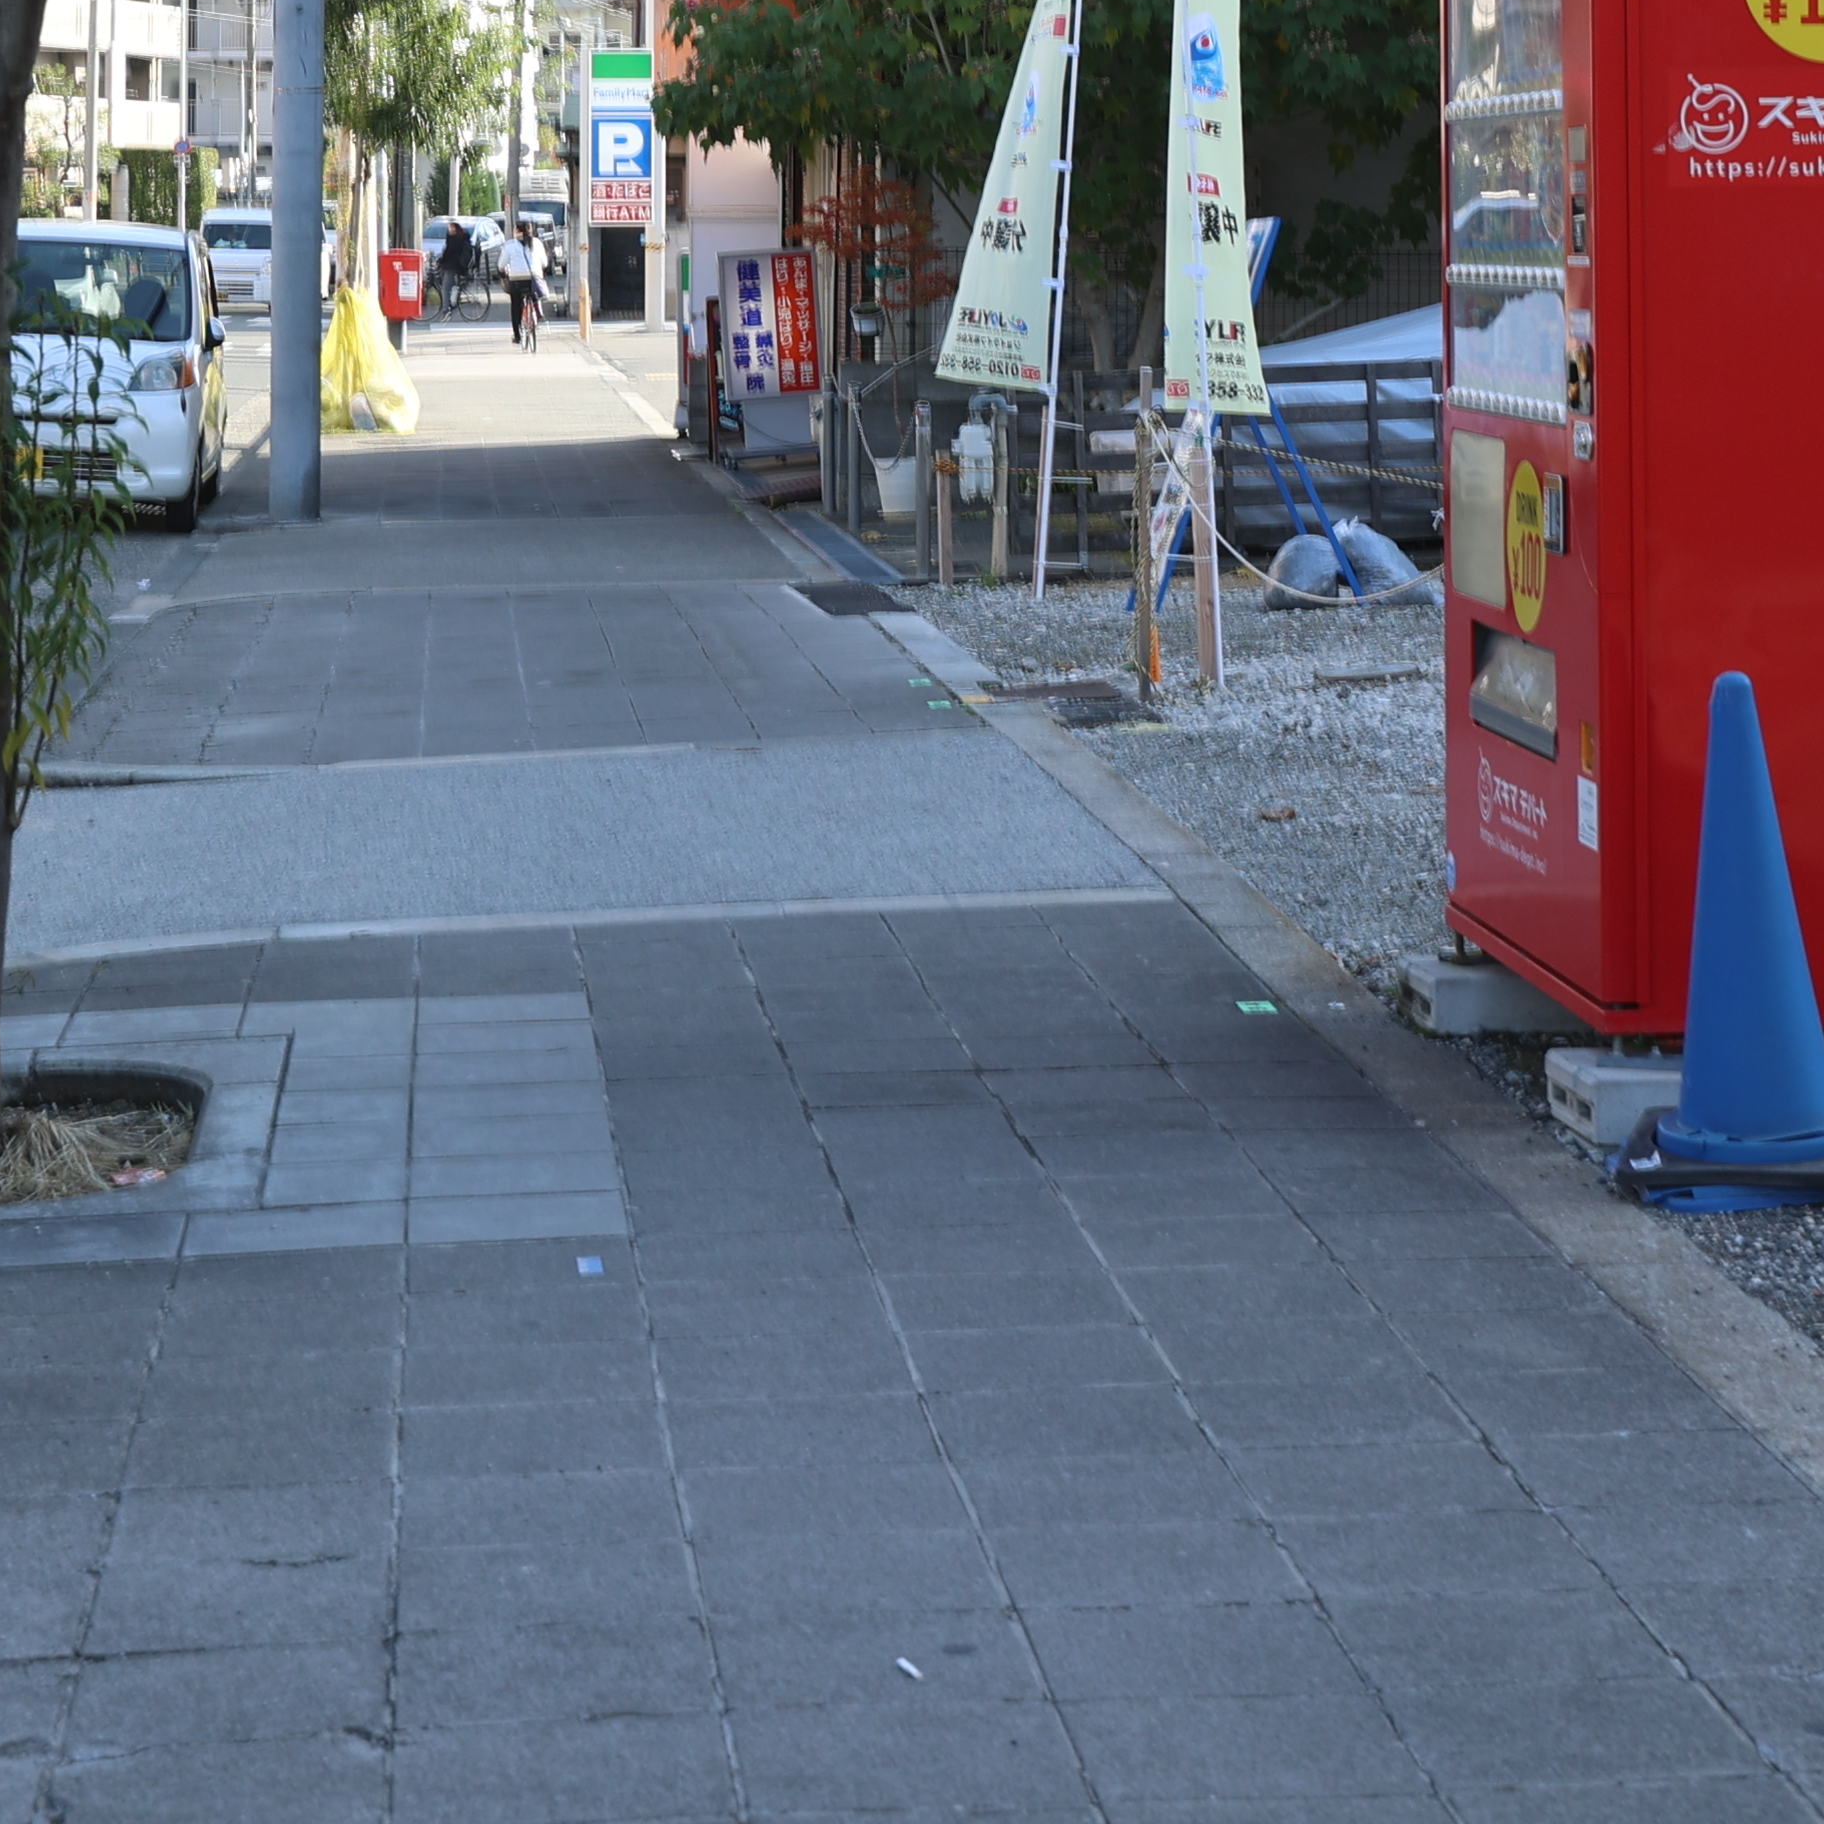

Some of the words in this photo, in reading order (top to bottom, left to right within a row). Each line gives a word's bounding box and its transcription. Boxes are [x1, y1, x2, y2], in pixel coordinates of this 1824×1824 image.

[593, 87, 650, 101] FamilyMart
[598, 122, 644, 176] P
[592, 182, 650, 199] 酒・たばこ
[592, 204, 650, 221] 銀行ATM
[1515, 490, 1538, 527] DRINK
[1512, 531, 1542, 600] ¥100
[1492, 775, 1518, 816] スキマ
[1519, 788, 1549, 829] デパート
